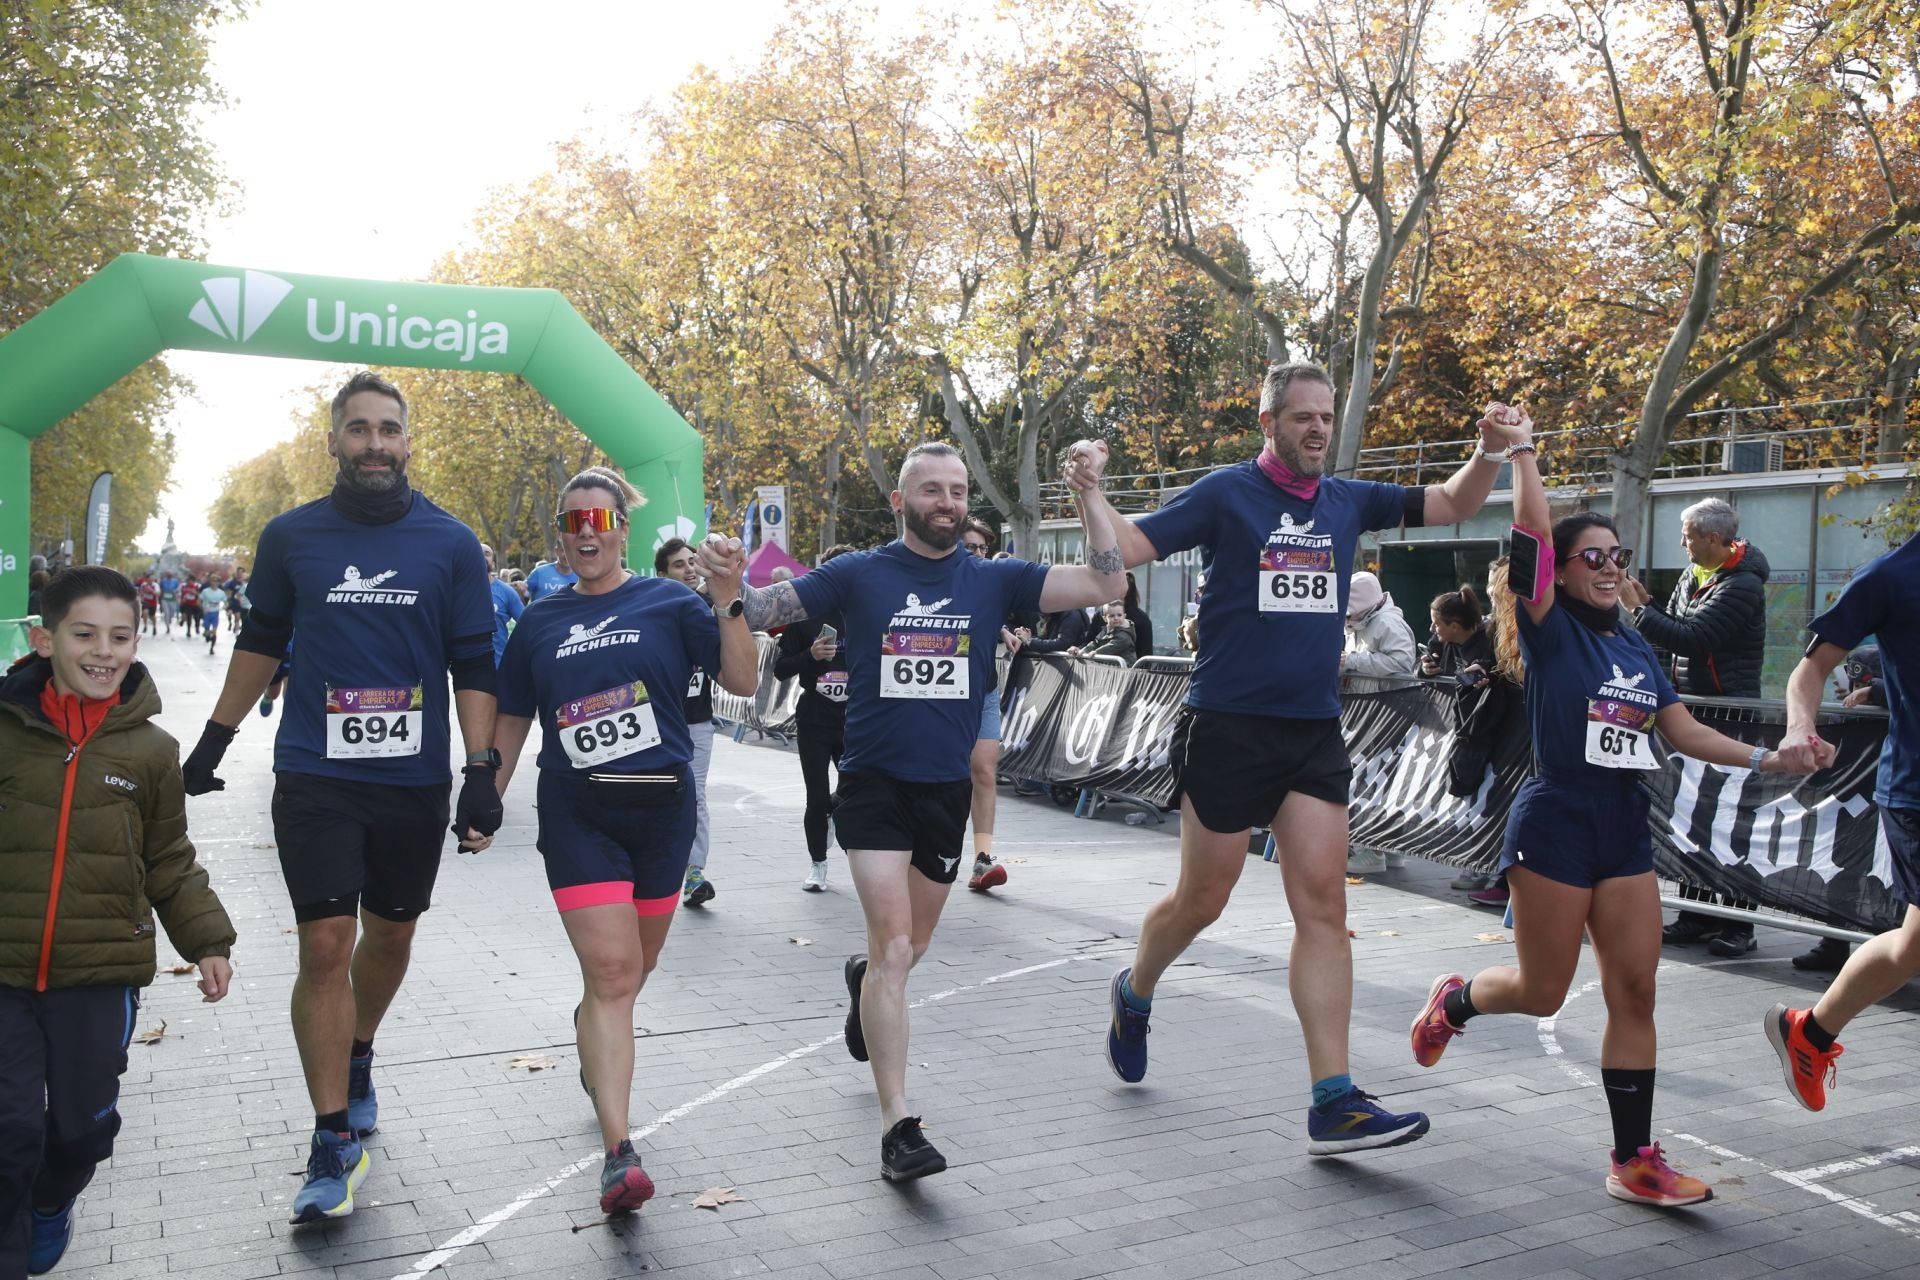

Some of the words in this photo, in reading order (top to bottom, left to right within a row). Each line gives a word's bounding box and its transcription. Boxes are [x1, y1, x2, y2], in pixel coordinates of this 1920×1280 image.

[307, 298, 508, 361] Unicaja
[1268, 535, 1332, 548] MICHELIN
[1271, 573, 1328, 599] 658
[326, 593, 417, 605] MICHELIN
[889, 617, 970, 629] MICHELIN
[556, 634, 640, 659] MICHELIN
[911, 641, 944, 649] EMPRESAS
[893, 659, 955, 685] 692
[359, 690, 386, 698] CARRERA
[359, 697, 395, 705] EMPRESAS
[581, 693, 607, 706] CARRERA
[608, 691, 616, 700] DE
[1597, 686, 1657, 708] MICHELIN
[583, 697, 618, 713] EMPRESAS
[342, 715, 409, 744] 694
[574, 712, 641, 753] 693
[1600, 727, 1638, 756] 657
